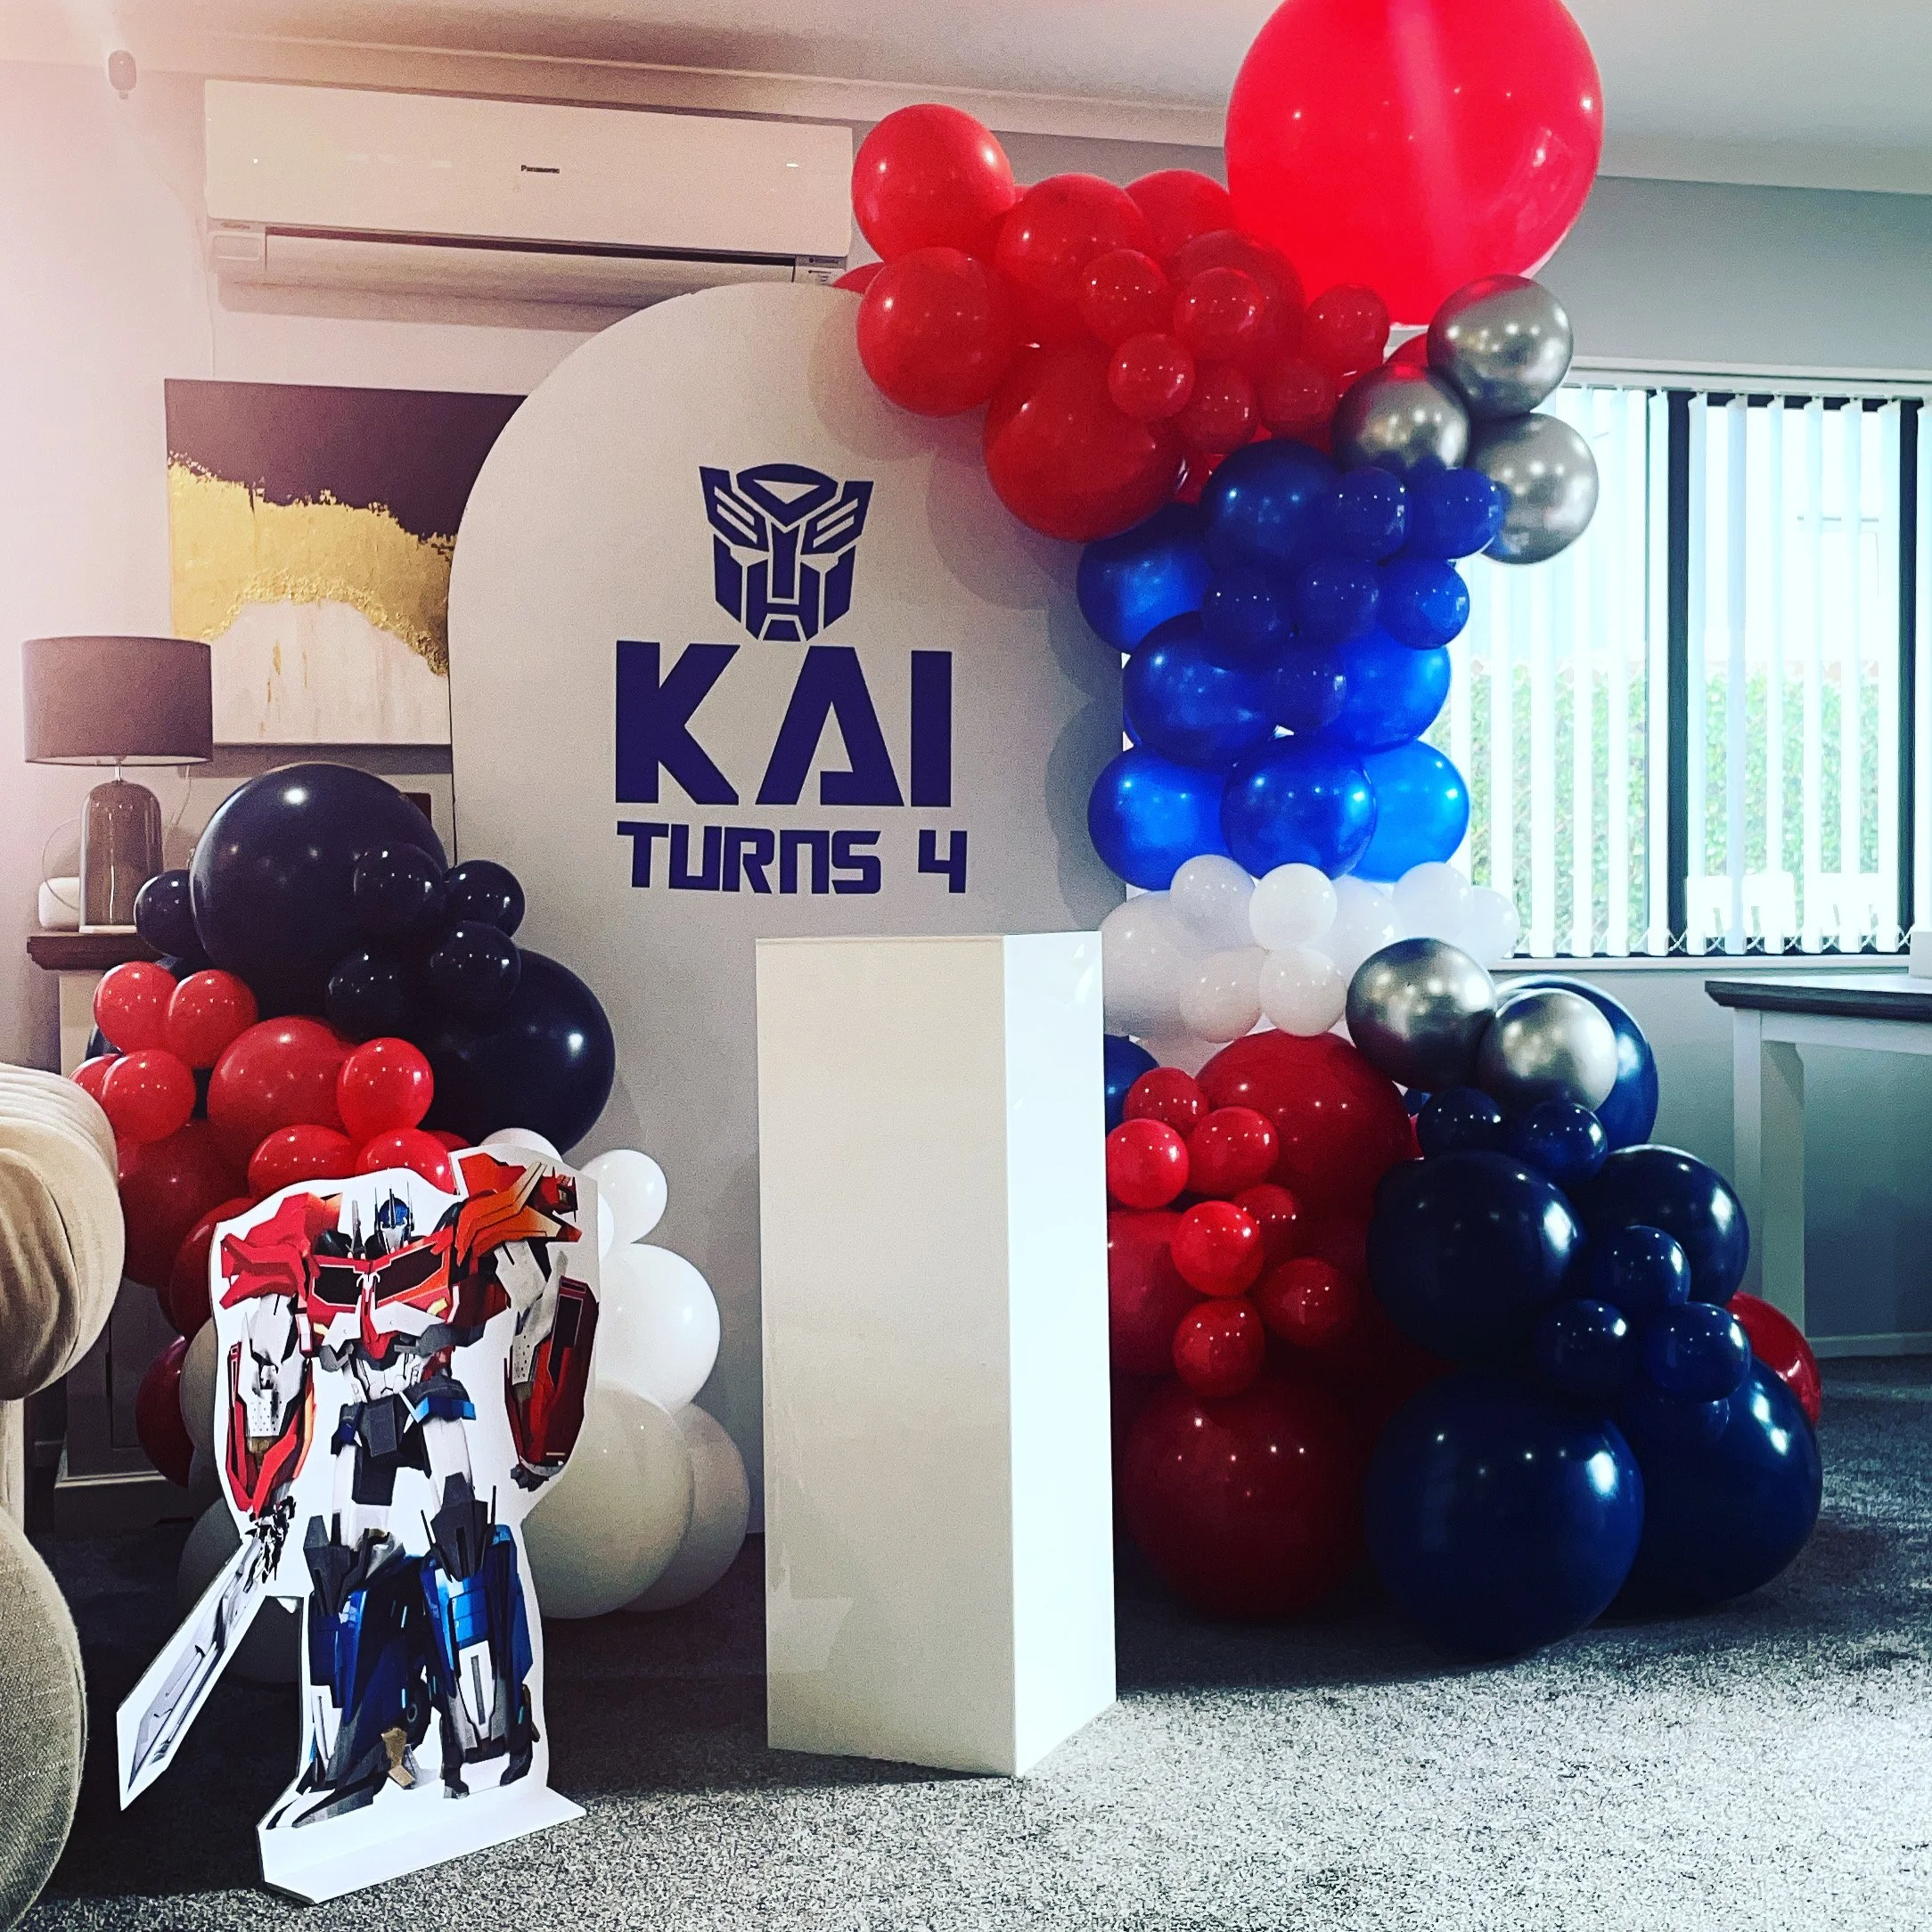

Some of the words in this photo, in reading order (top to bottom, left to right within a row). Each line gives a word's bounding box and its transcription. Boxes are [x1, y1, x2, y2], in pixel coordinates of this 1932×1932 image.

[615, 640, 953, 807] KAI
[616, 821, 882, 895] TURNS
[917, 829, 968, 894] 4
